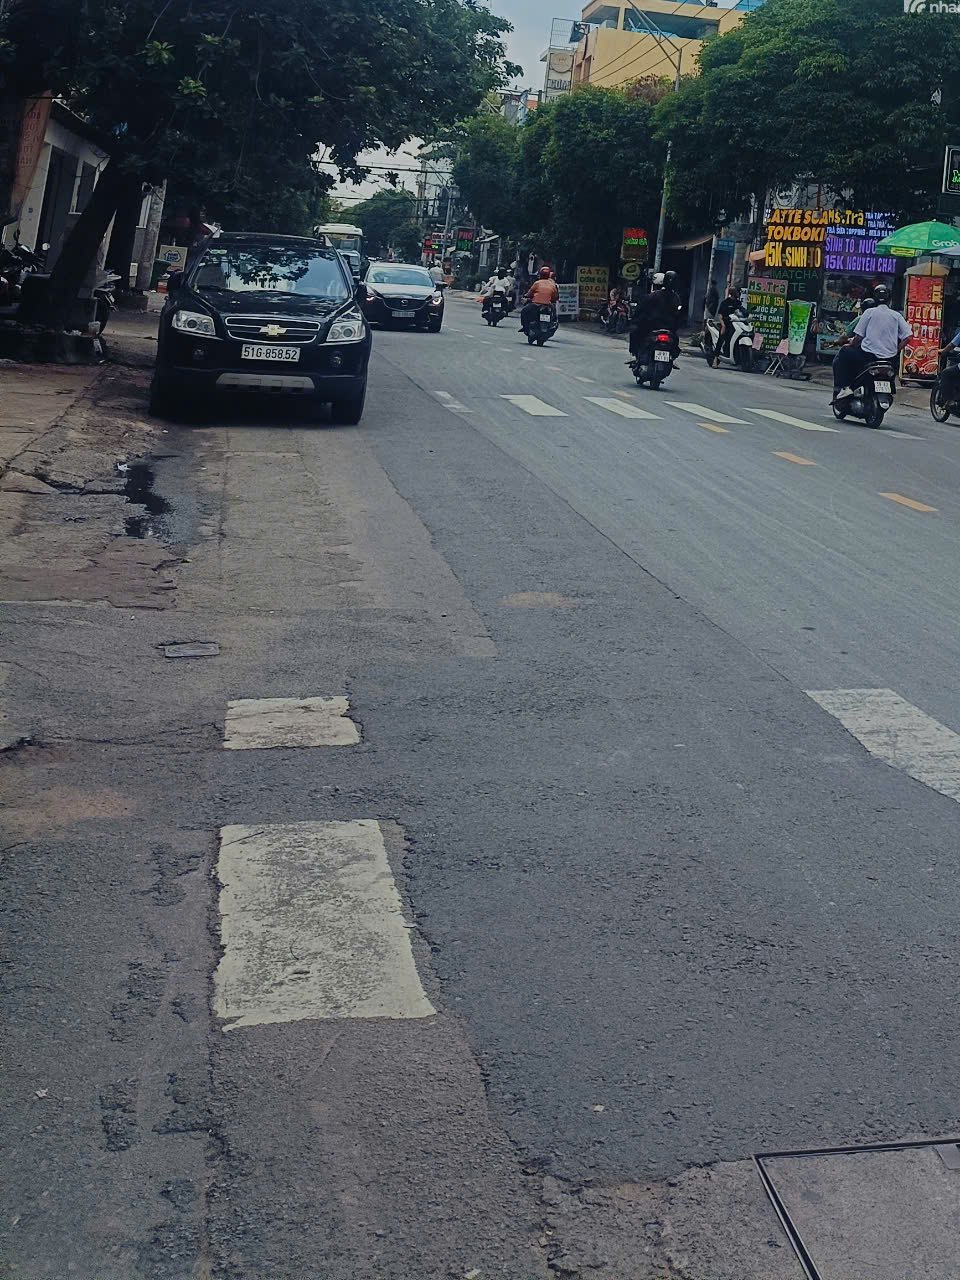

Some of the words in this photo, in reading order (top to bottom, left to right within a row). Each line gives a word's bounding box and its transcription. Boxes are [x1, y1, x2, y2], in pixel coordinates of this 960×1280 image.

[766, 225, 826, 242] TOKBOKI
[931, 239, 960, 247] Grab
[764, 241, 783, 267] 15K
[785, 246, 808, 268] SINH
[825, 254, 844, 270] 15K
[244, 346, 298, 360] 51G-858.52
